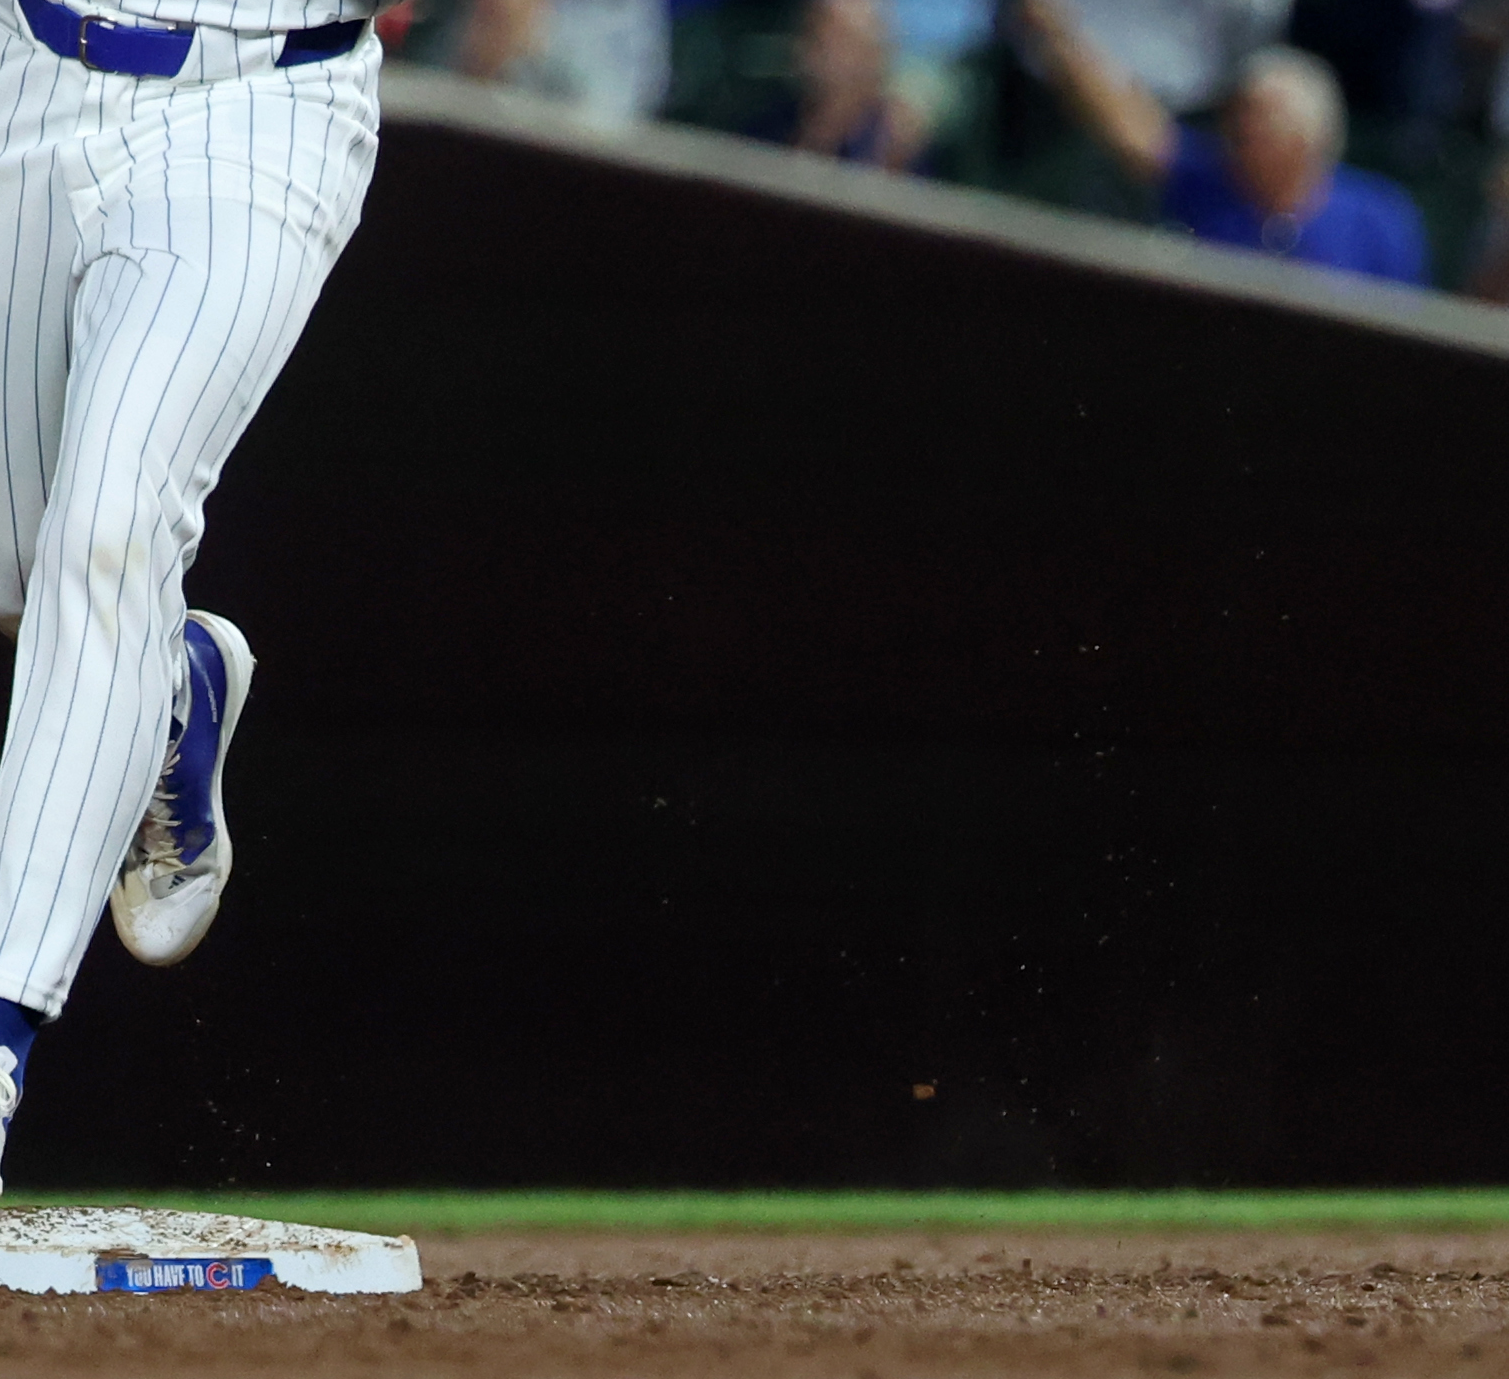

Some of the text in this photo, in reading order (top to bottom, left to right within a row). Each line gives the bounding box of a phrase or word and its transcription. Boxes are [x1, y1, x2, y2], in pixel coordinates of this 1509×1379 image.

[126, 1264, 152, 1287] YOU
[154, 1265, 186, 1287] HAVE
[187, 1264, 204, 1287] TO
[231, 1265, 244, 1287] IT
